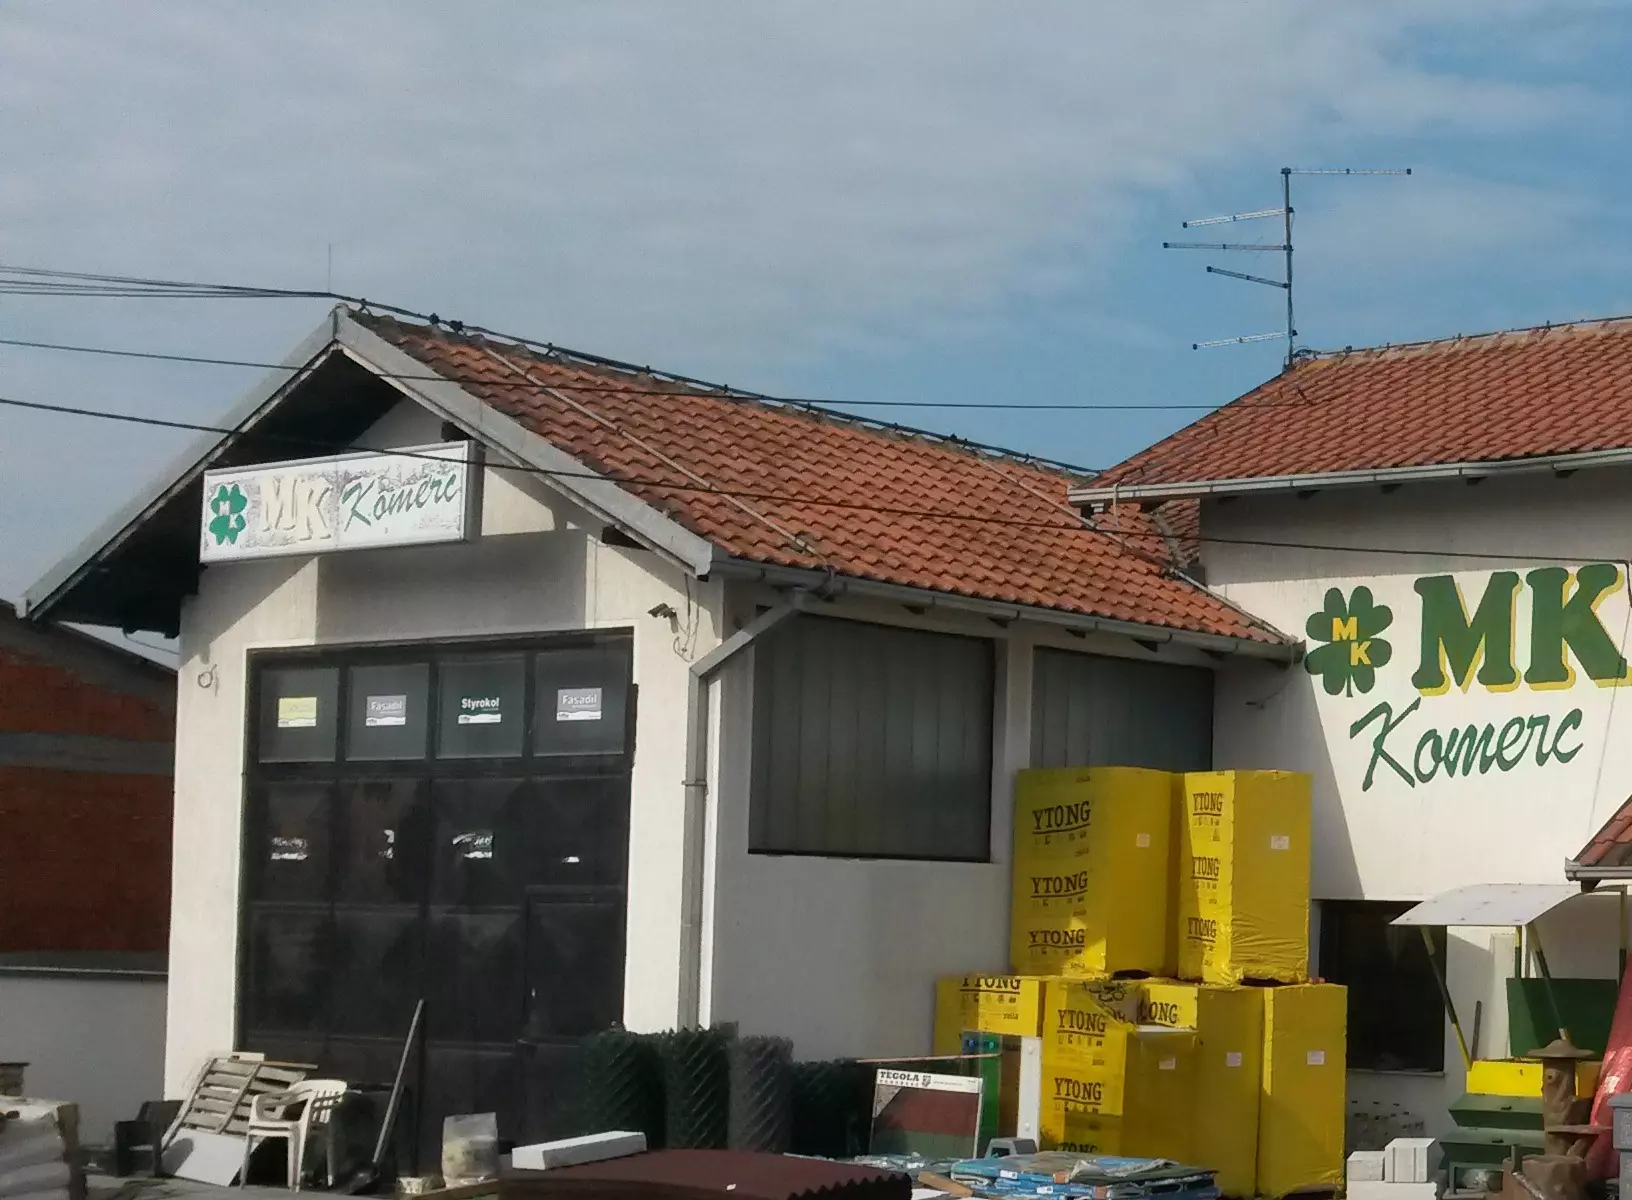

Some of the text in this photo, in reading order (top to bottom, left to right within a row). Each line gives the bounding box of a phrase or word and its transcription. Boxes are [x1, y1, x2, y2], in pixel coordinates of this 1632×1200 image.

[259, 473, 457, 541] MK Komerc
[1332, 617, 1357, 641] M
[1350, 641, 1371, 666] K
[461, 697, 500, 711] Styrokol
[1350, 697, 1584, 792] Komerc
[1193, 792, 1223, 812] YTONG
[1032, 800, 1091, 830] YTONG
[1192, 856, 1219, 877] YTONG
[1030, 870, 1088, 894] YTONG
[1028, 928, 1085, 944] YTONG
[1057, 1009, 1106, 1032] YTONG
[880, 1071, 920, 1082] TEGOLA
[1054, 1077, 1102, 1100] YTONG
